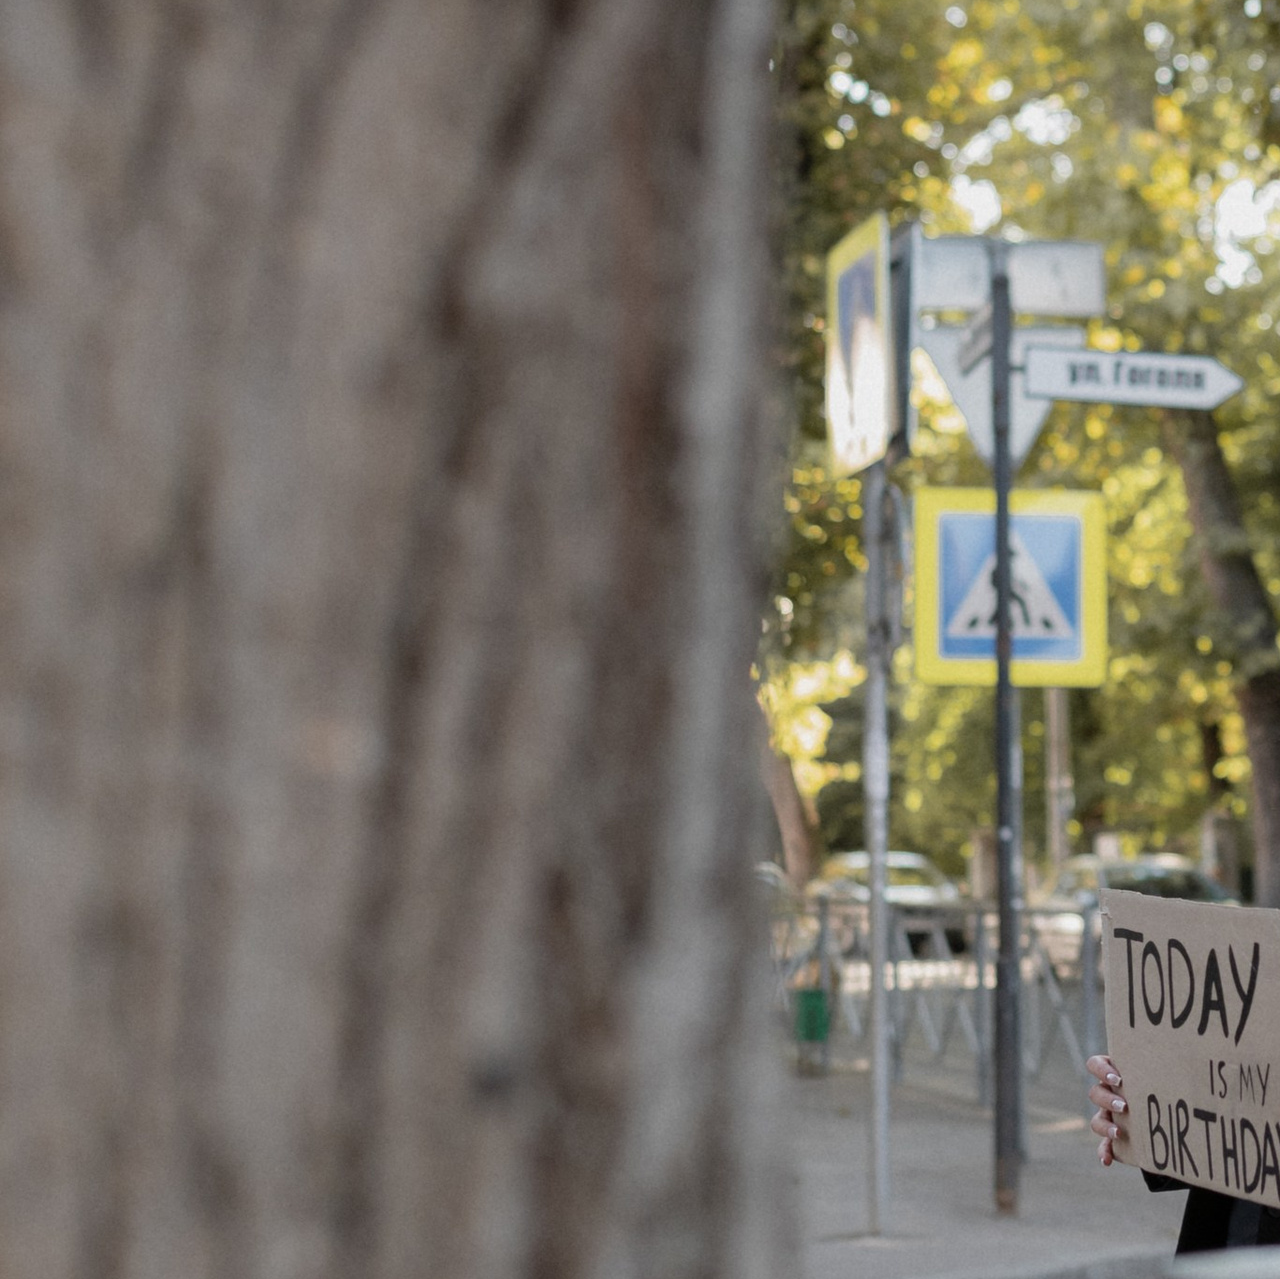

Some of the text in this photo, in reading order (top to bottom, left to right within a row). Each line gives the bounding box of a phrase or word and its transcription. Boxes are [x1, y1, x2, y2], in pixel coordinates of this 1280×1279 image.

[1113, 927, 1260, 1047] TODAY
[1209, 1059, 1228, 1099] IS
[1239, 1062, 1271, 1107] MY
